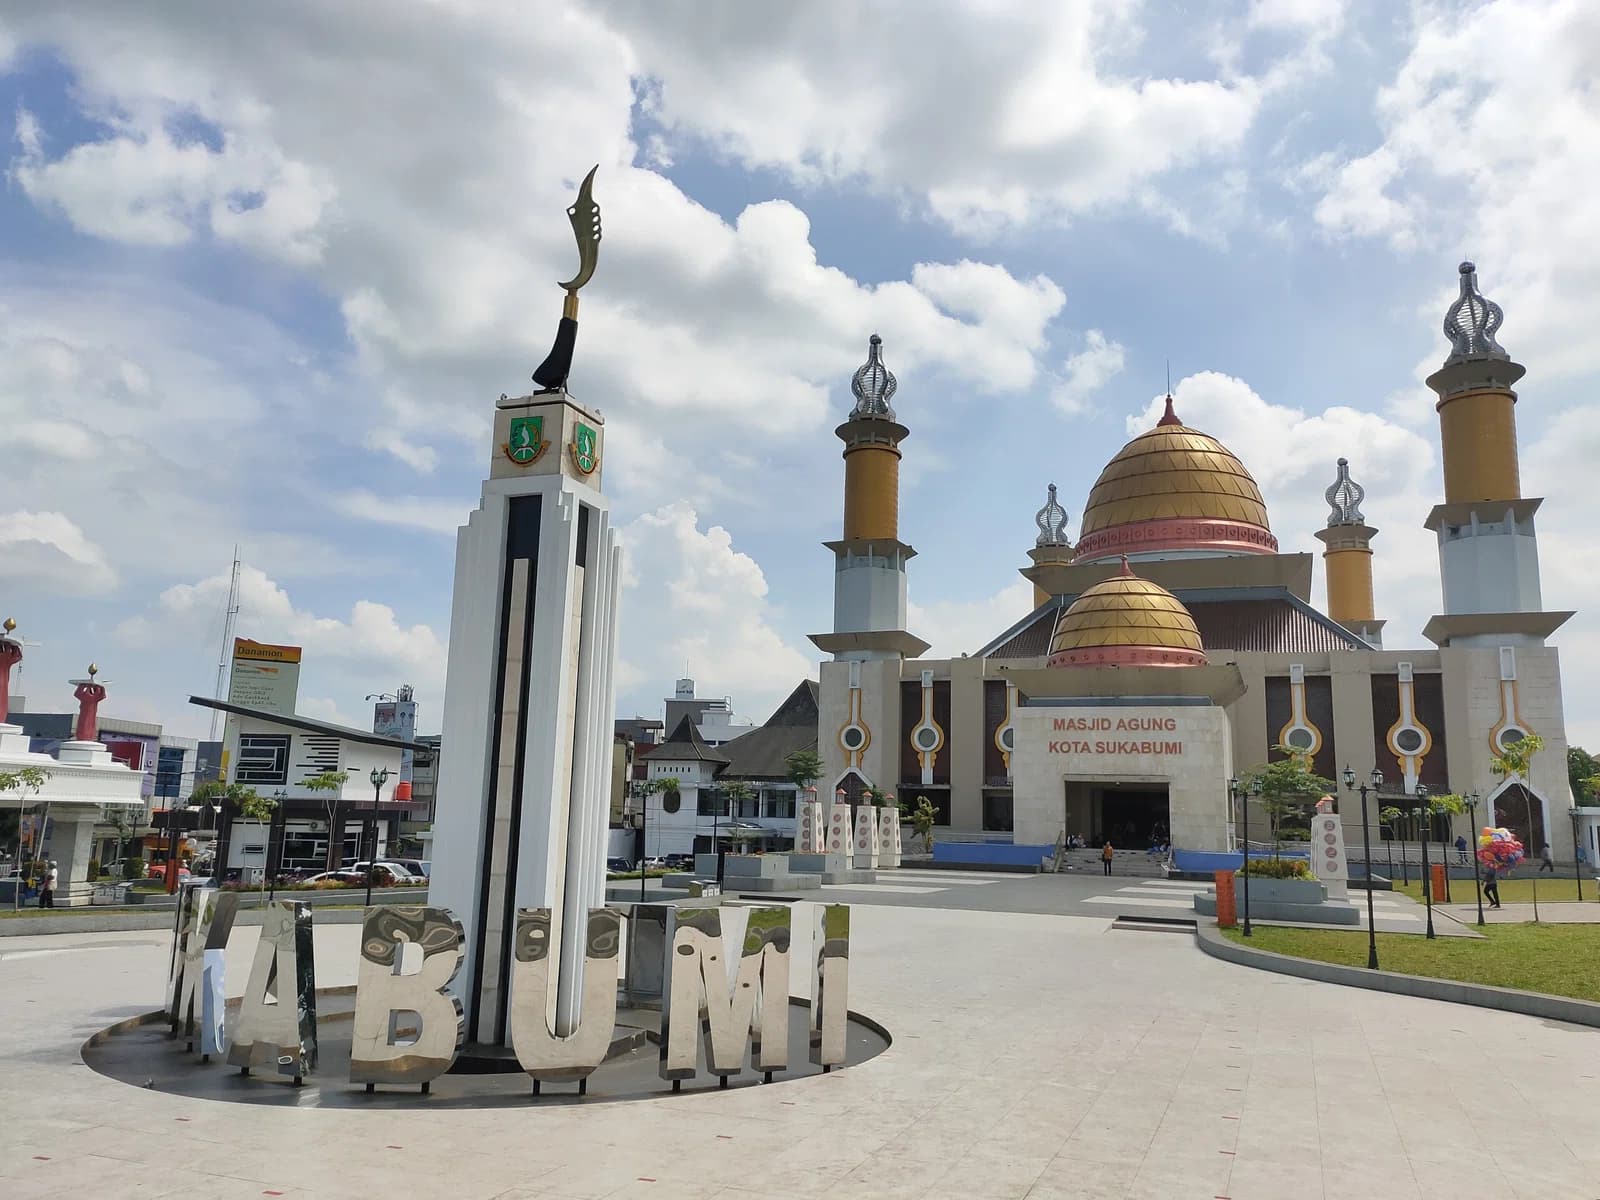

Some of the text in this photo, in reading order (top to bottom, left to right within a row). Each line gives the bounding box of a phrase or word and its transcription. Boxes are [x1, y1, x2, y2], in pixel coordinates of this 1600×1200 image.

[237, 646, 283, 657] Danamon
[1053, 718, 1177, 731] MASJID AGUNG
[1048, 741, 1183, 754] KOTA SUKABUMI
